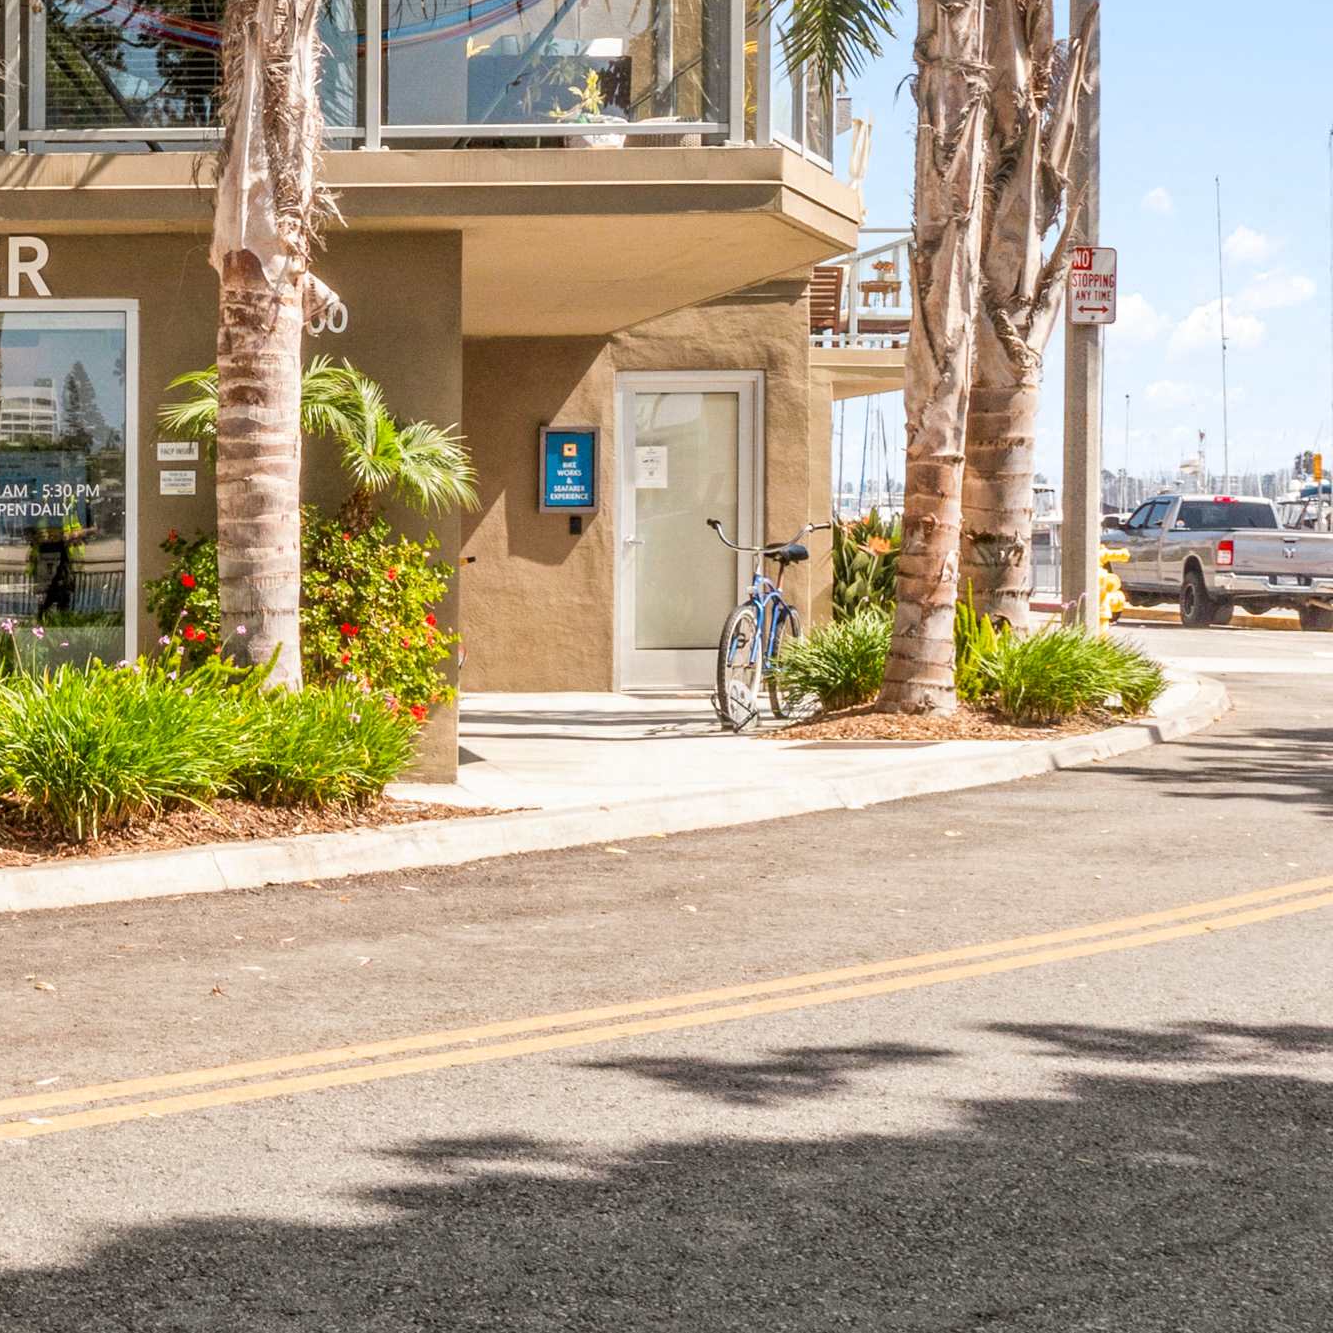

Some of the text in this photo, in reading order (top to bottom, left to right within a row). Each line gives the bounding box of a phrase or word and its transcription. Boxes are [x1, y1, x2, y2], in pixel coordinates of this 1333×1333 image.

[1073, 250, 1089, 267] NO
[1072, 274, 1114, 288] STOPPING
[1075, 291, 1112, 301] ANY TIME
[562, 461, 577, 469] BIKE
[556, 469, 582, 477] WORKS
[2, 484, 28, 497] AM
[42, 484, 72, 498] 5:30
[76, 484, 100, 497] PM
[31, 503, 73, 517] DAILY
